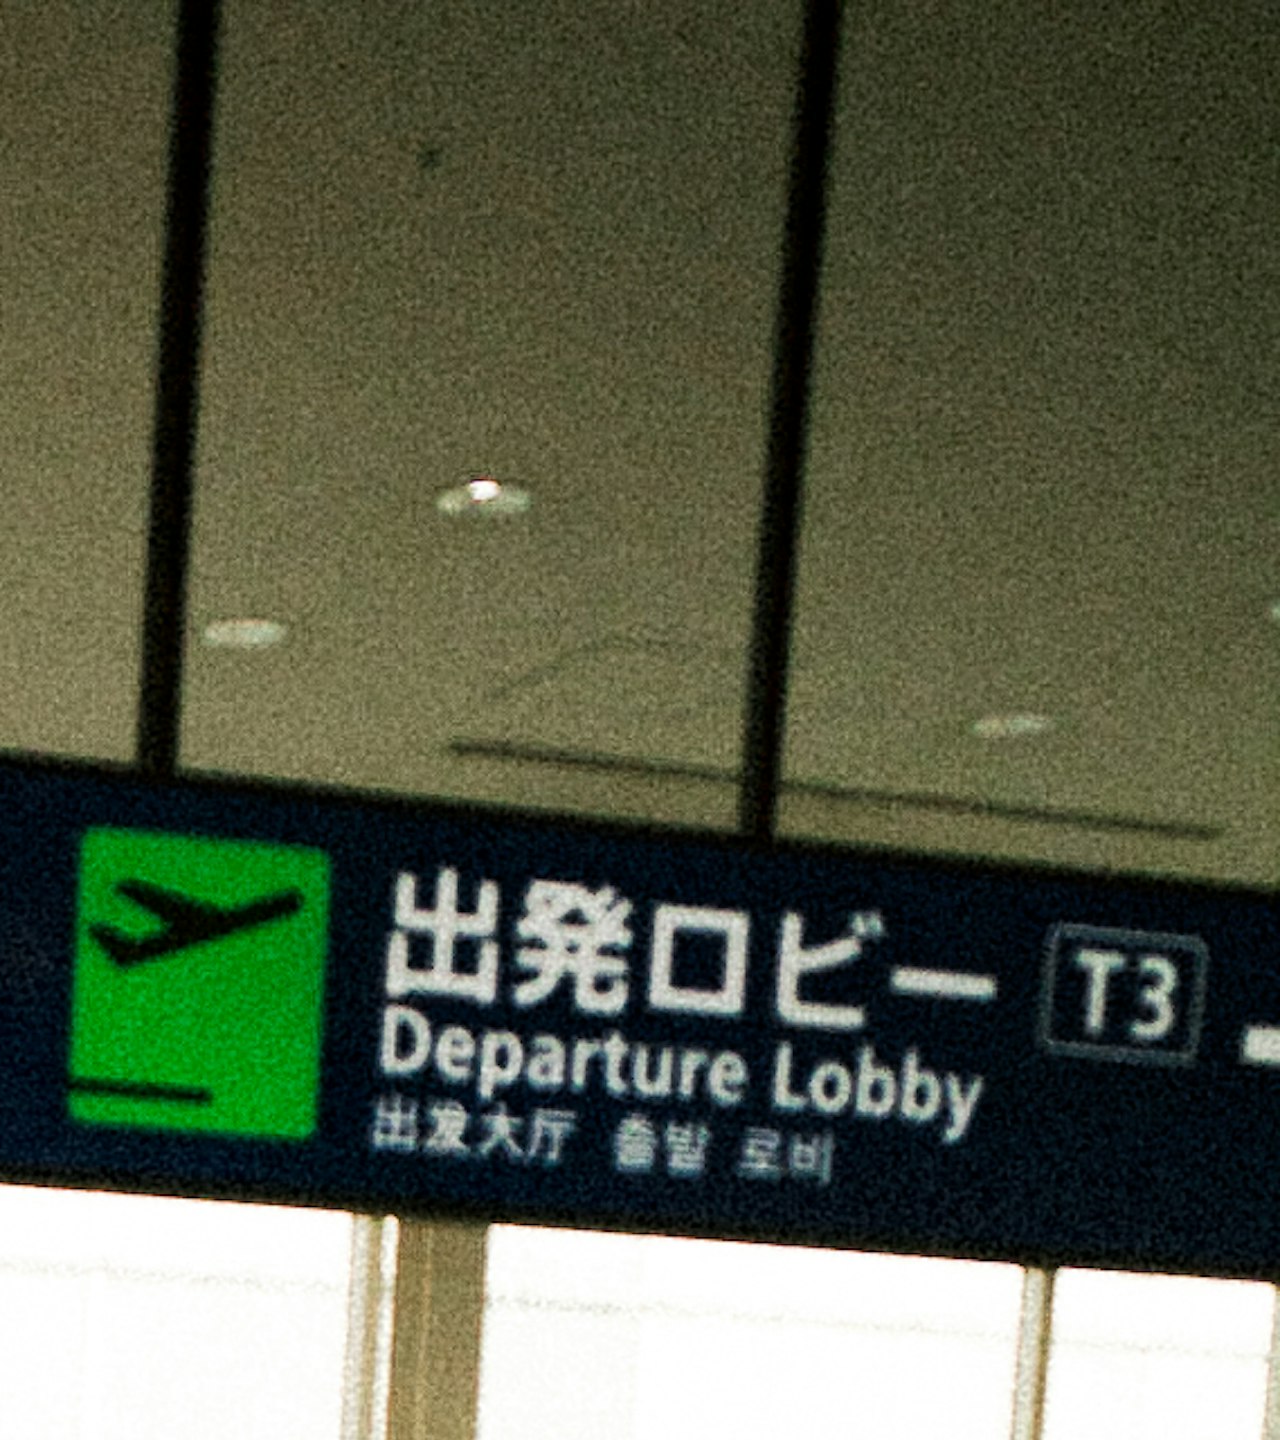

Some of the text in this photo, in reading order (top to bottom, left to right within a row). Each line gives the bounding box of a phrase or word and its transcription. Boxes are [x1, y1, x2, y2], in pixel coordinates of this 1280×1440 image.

[386, 865, 997, 1030] 出発ロビー
[1077, 949, 1177, 1039] T3
[381, 1004, 983, 1144] Departure Lobby
